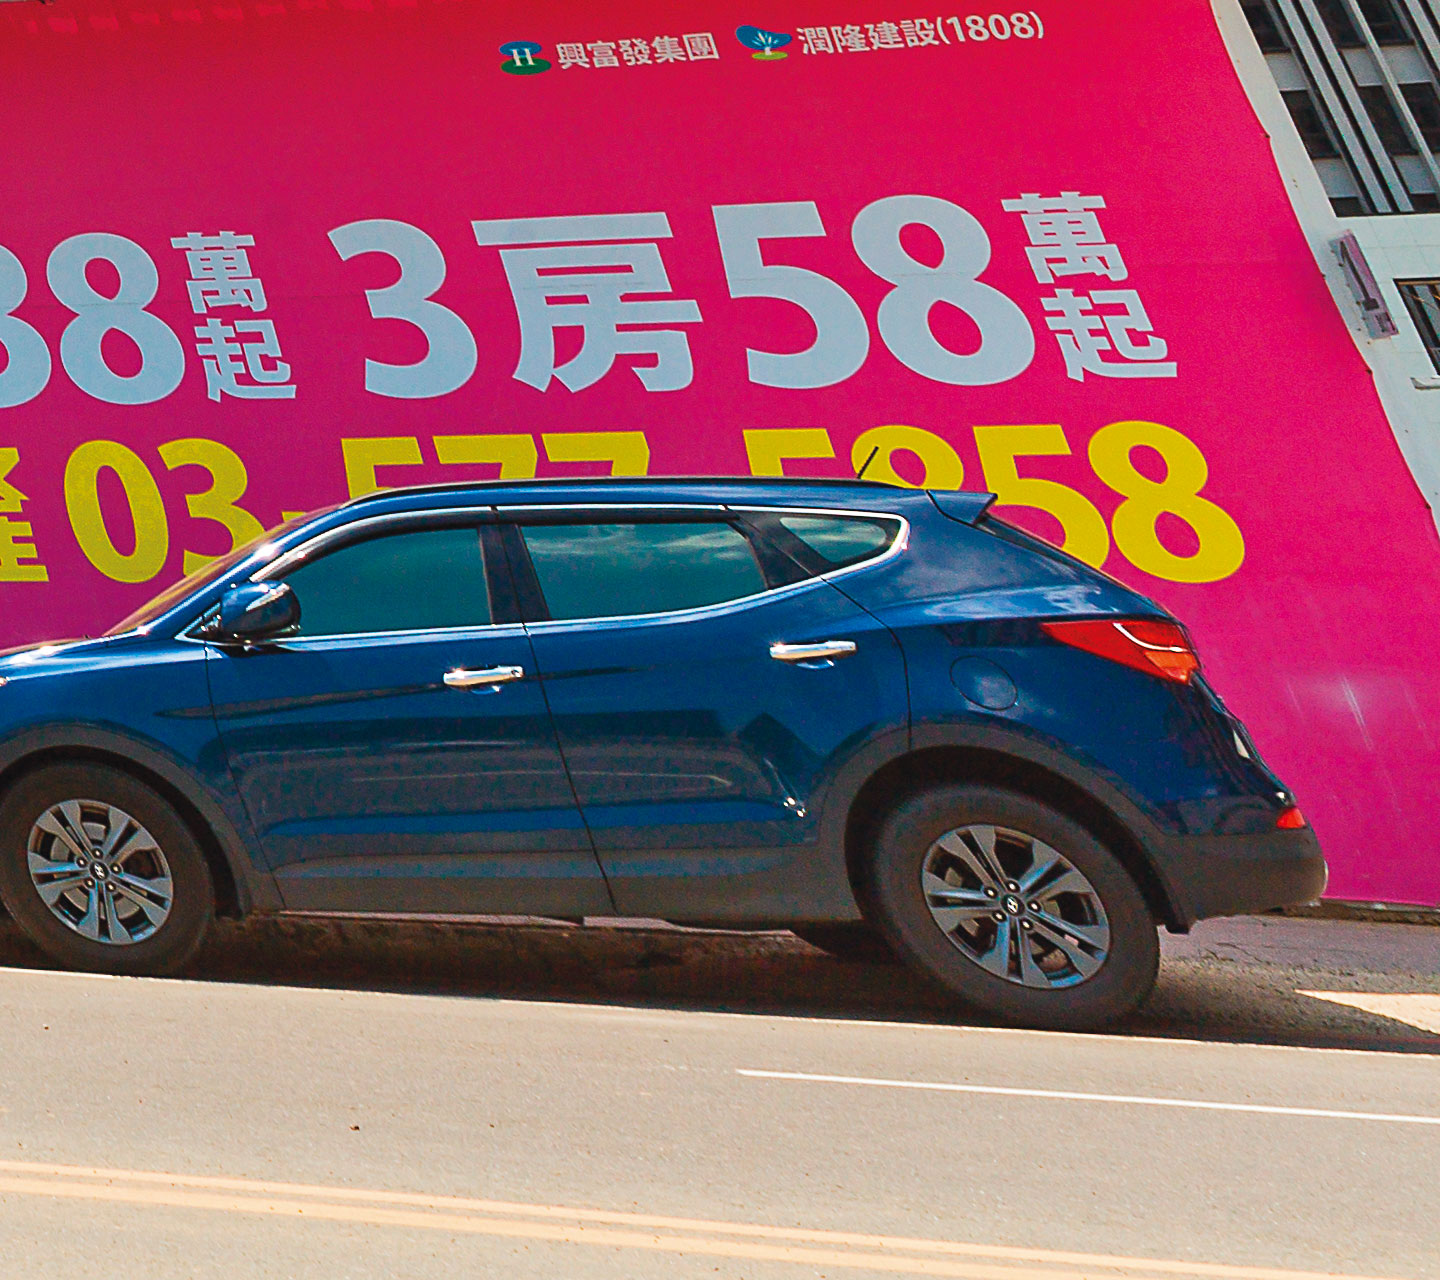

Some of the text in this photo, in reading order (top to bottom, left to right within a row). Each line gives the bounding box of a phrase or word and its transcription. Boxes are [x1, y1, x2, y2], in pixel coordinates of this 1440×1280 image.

[555, 32, 720, 70] 興富發集團
